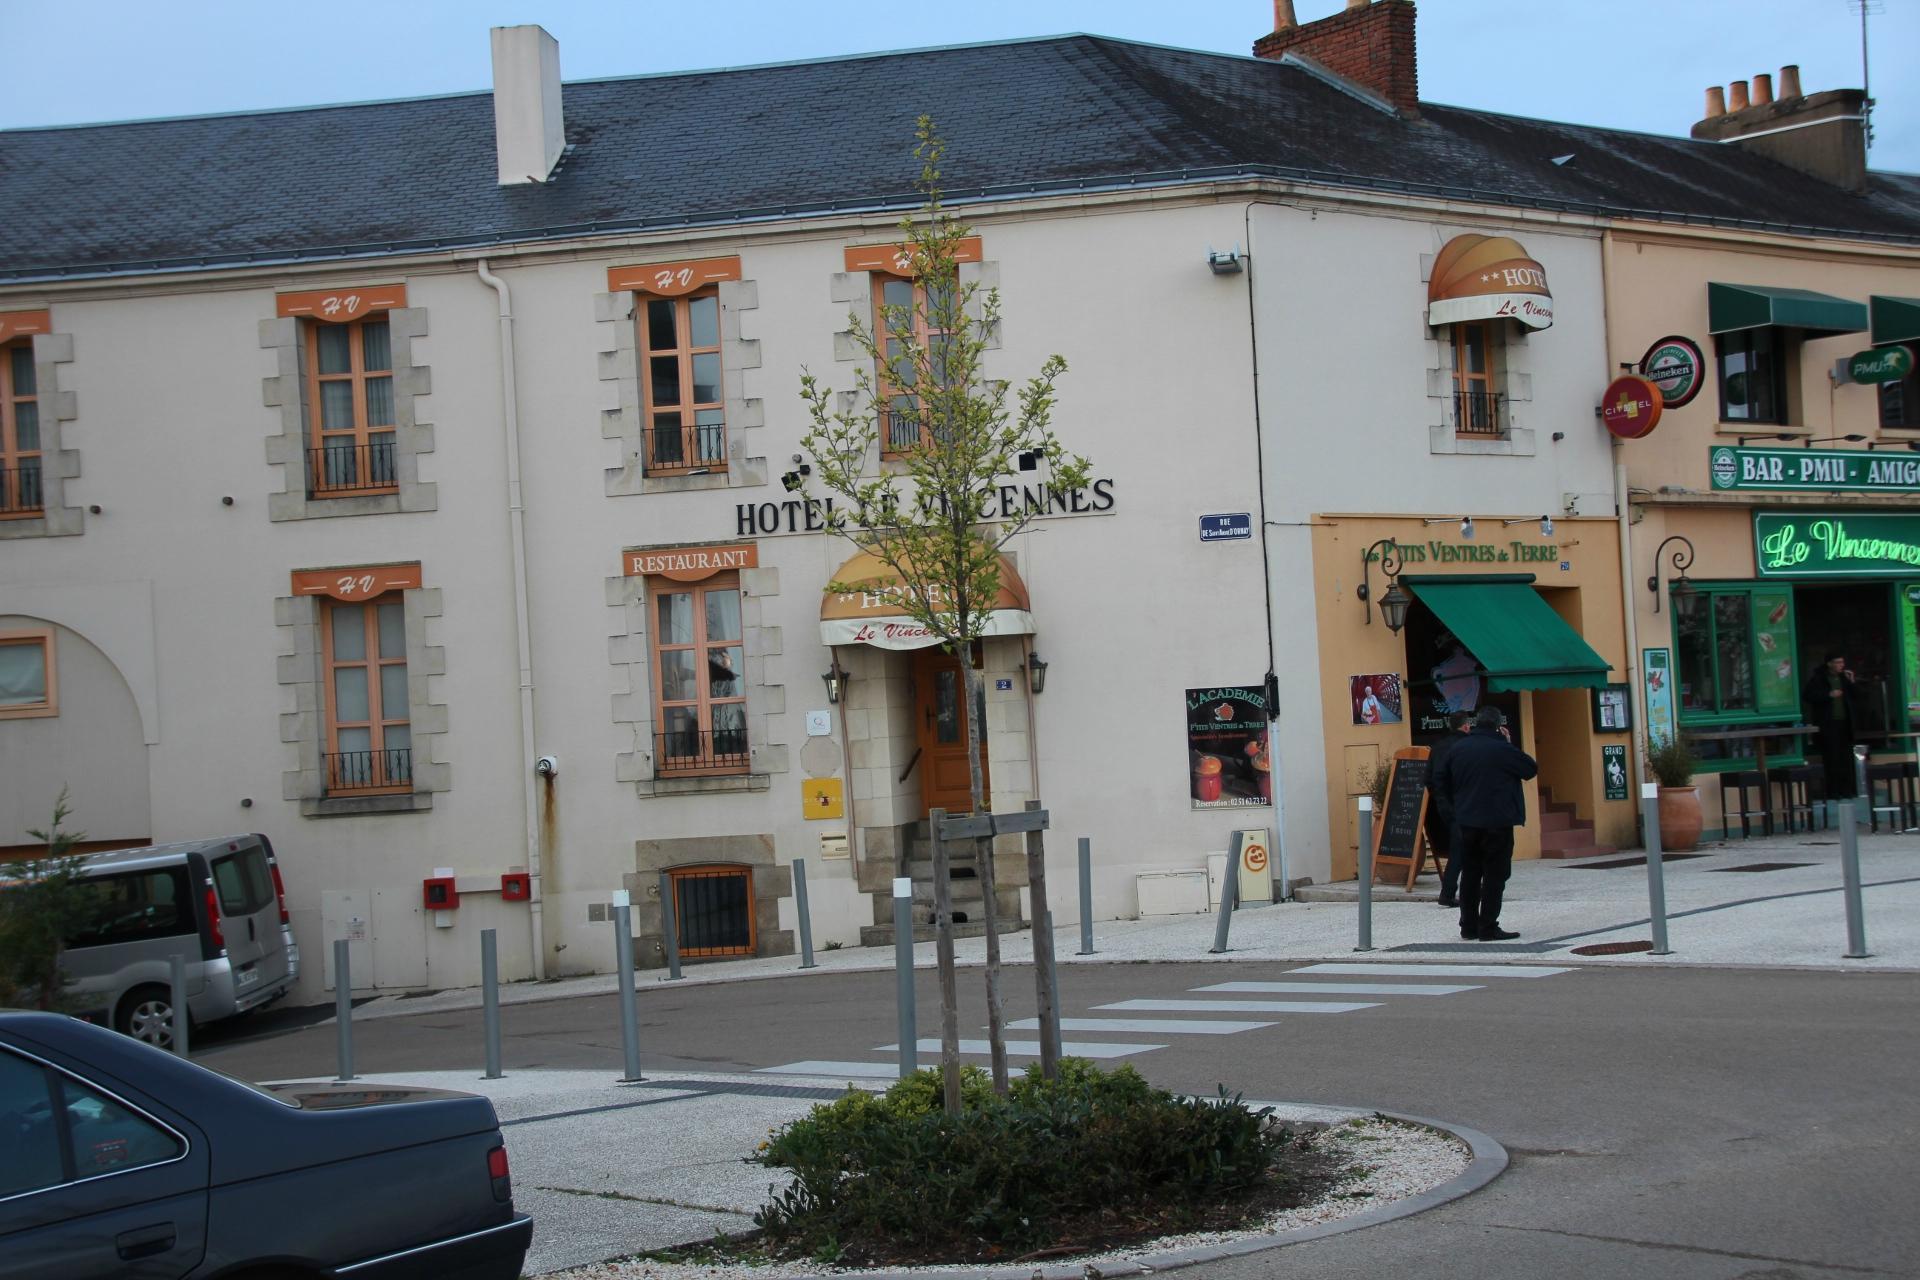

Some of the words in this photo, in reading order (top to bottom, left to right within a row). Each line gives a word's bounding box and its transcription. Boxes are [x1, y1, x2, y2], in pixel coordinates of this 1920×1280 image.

[655, 268, 694, 288] HV
[322, 295, 360, 315] HV
[1496, 300, 1517, 315] Le
[1648, 366, 1690, 380] Heineken
[1742, 456, 1784, 481] BAR
[1800, 457, 1847, 482] PMU
[1867, 460, 1920, 484] AMIG
[736, 497, 846, 535] HOTEL
[916, 478, 1115, 522] VICENNES
[1428, 541, 1495, 562] VENTRES
[1509, 541, 1558, 562] TERRE
[1762, 524, 1810, 568] Le
[632, 550, 748, 573] RESTAURANT
[337, 575, 375, 594] HV
[854, 624, 875, 641] Le
[1604, 746, 1623, 755] GRAND
